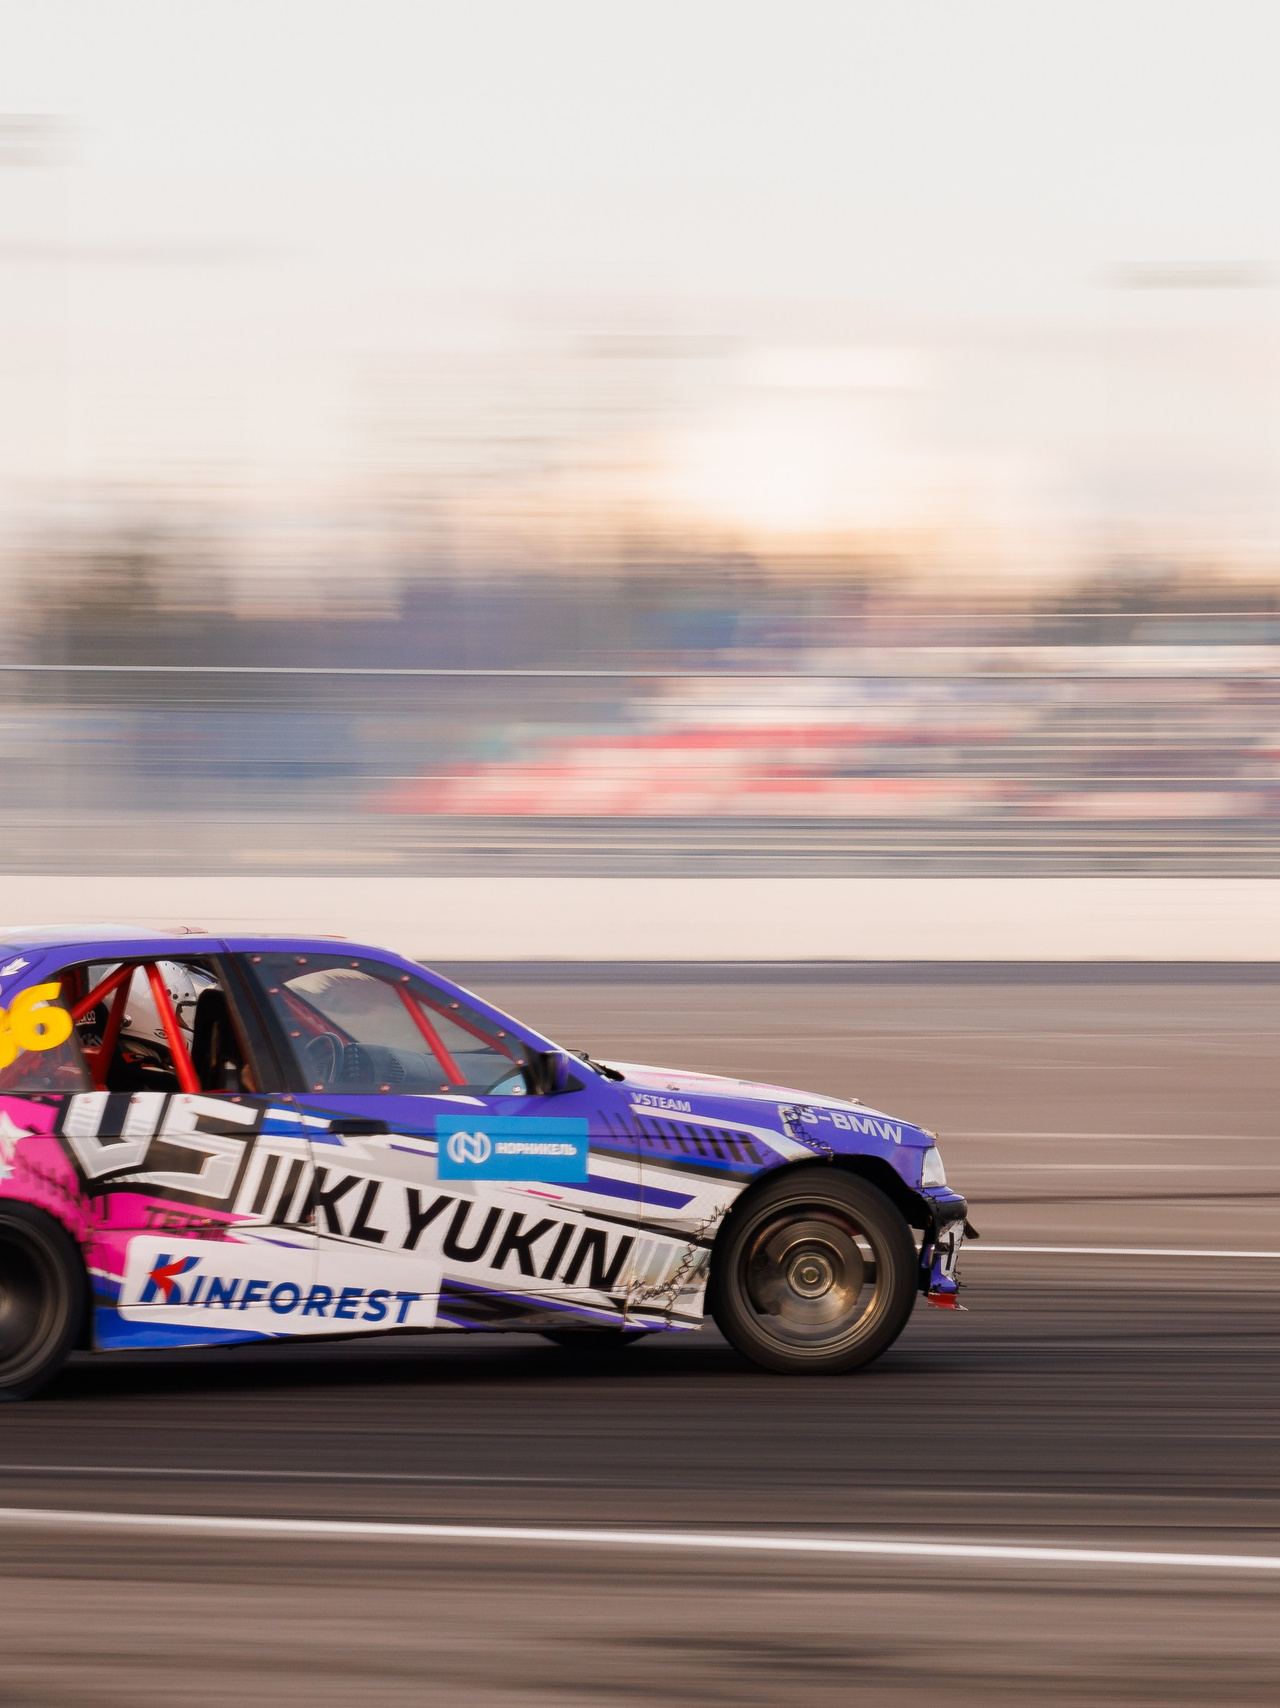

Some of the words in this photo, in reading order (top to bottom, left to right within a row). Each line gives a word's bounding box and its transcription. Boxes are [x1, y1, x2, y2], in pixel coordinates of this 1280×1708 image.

[630, 1091, 692, 1112] VSTEAM
[495, 1142, 577, 1156] НОРНИКЕЛЬ
[301, 1166, 634, 1294] KLYUKIN
[139, 1253, 423, 1325] KINFOREST
